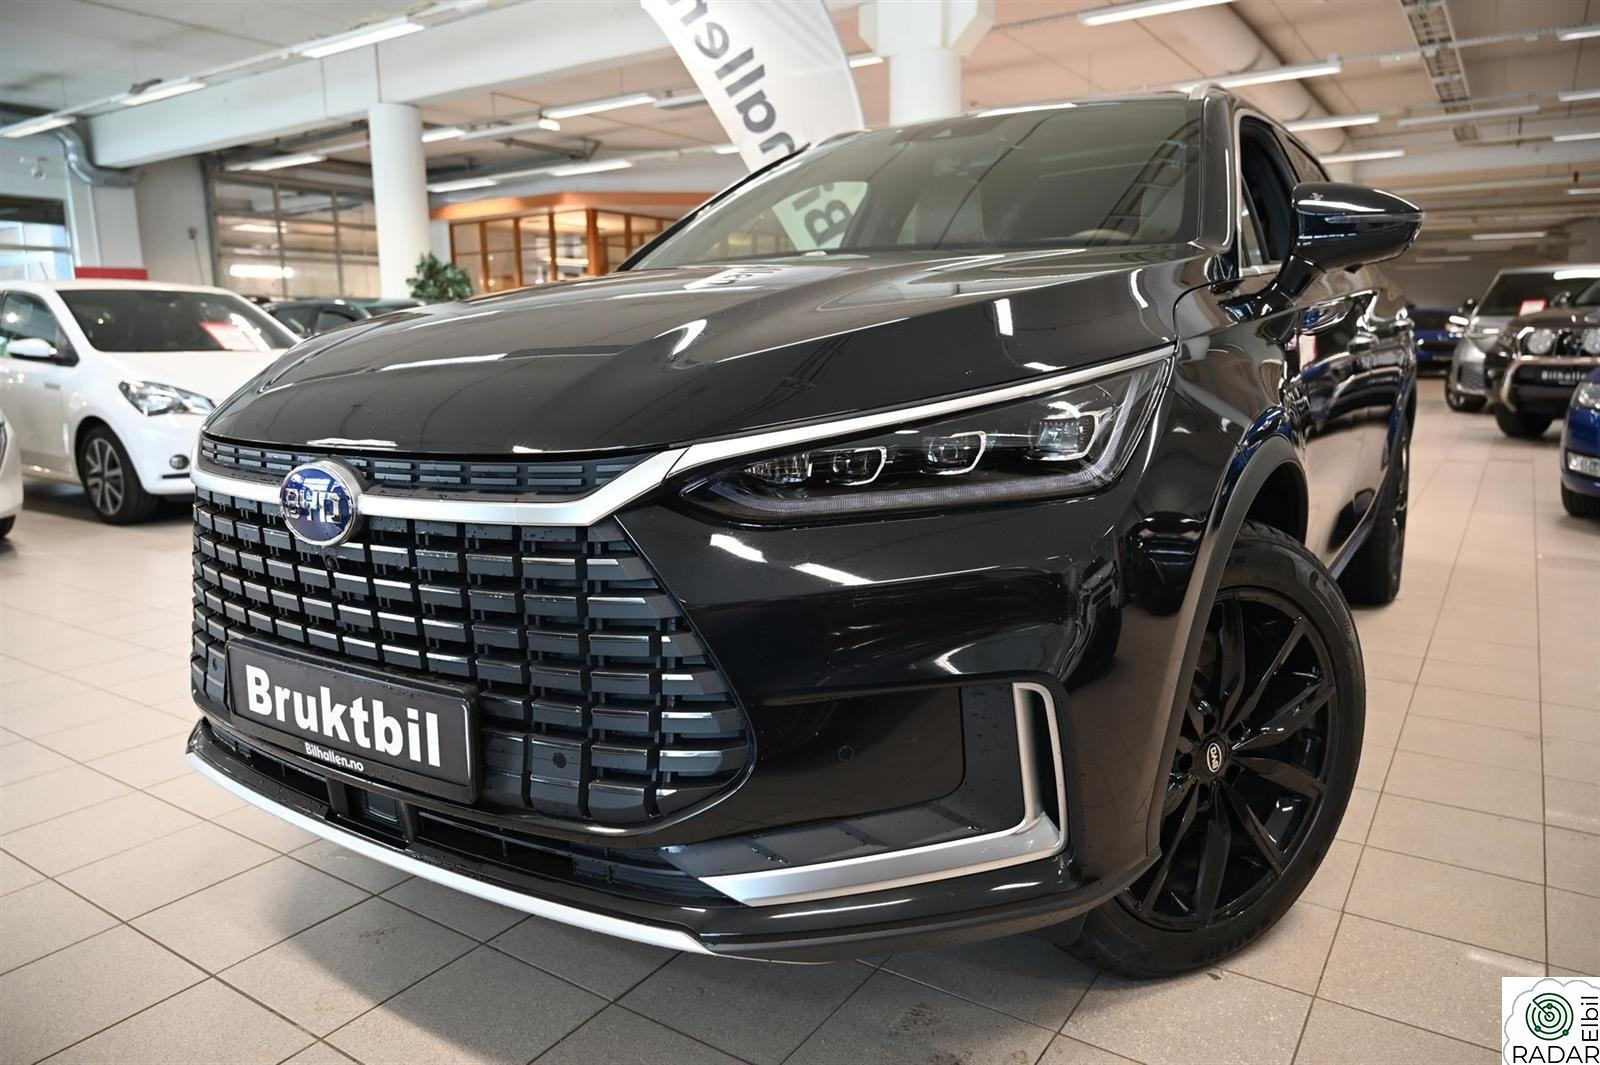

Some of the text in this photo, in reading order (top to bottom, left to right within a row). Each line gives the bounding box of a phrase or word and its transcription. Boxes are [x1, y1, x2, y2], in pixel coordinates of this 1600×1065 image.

[285, 487, 342, 523] BYD
[245, 664, 441, 768] Bruktbil
[304, 742, 364, 772] Bilhallen.no
[1210, 746, 1219, 769] BYD
